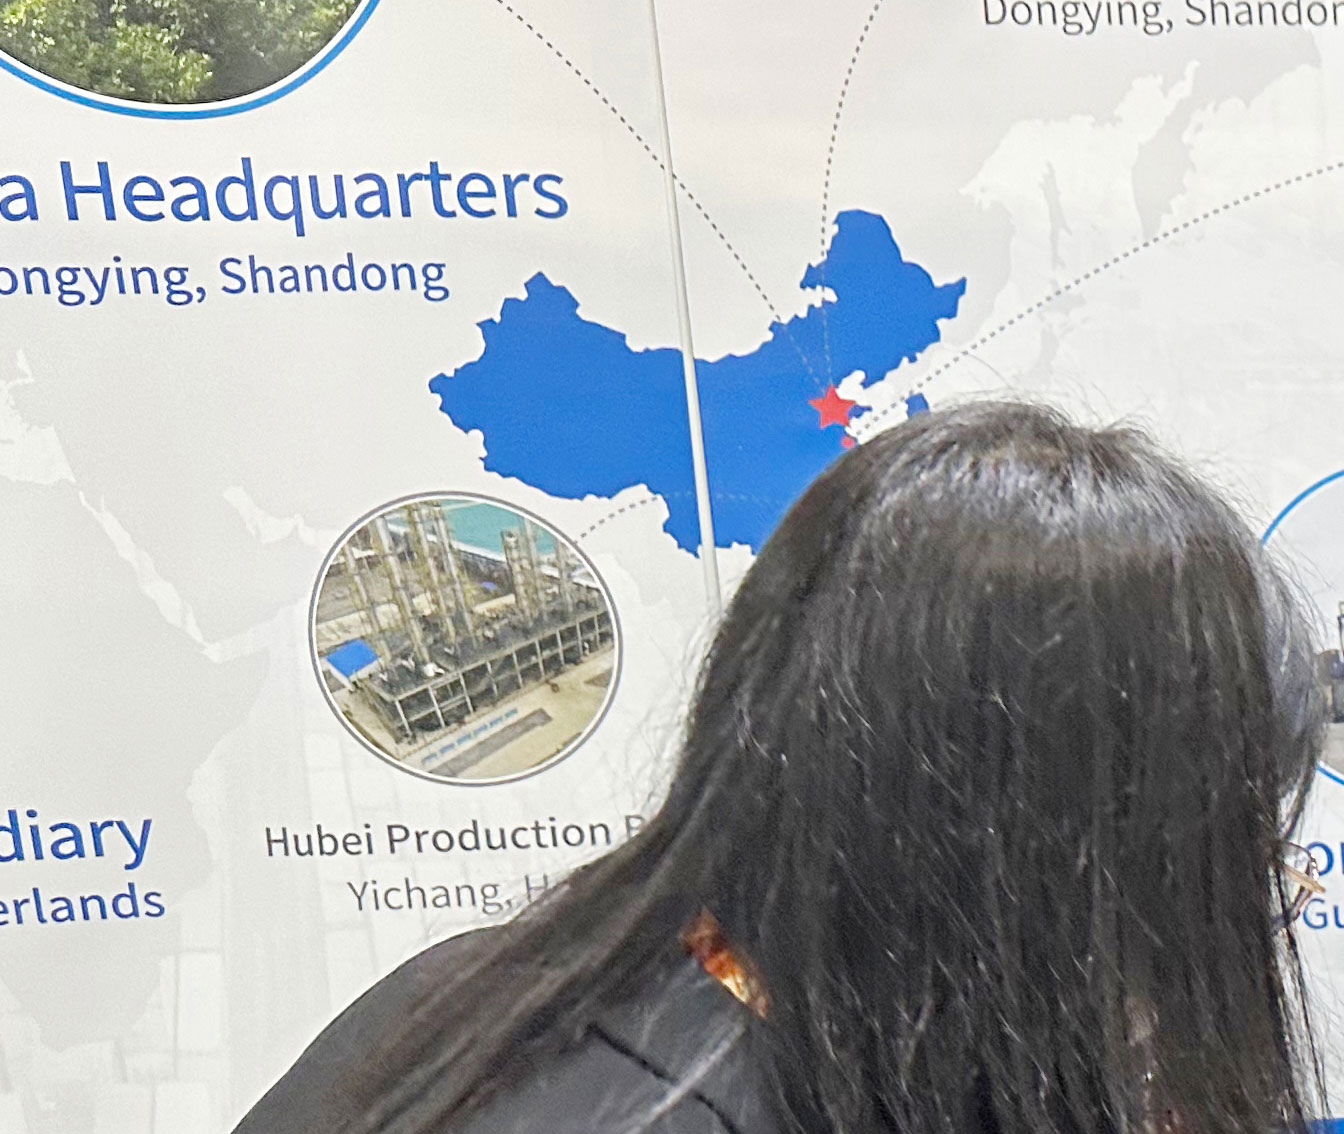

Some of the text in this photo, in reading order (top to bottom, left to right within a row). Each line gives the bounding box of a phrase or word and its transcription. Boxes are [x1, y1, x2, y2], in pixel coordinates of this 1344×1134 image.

[59, 157, 569, 237] Headquarters
[221, 252, 450, 301] Shandong
[265, 822, 374, 858] Hubei
[388, 815, 611, 855] Production
[347, 876, 516, 915] Yichang,
